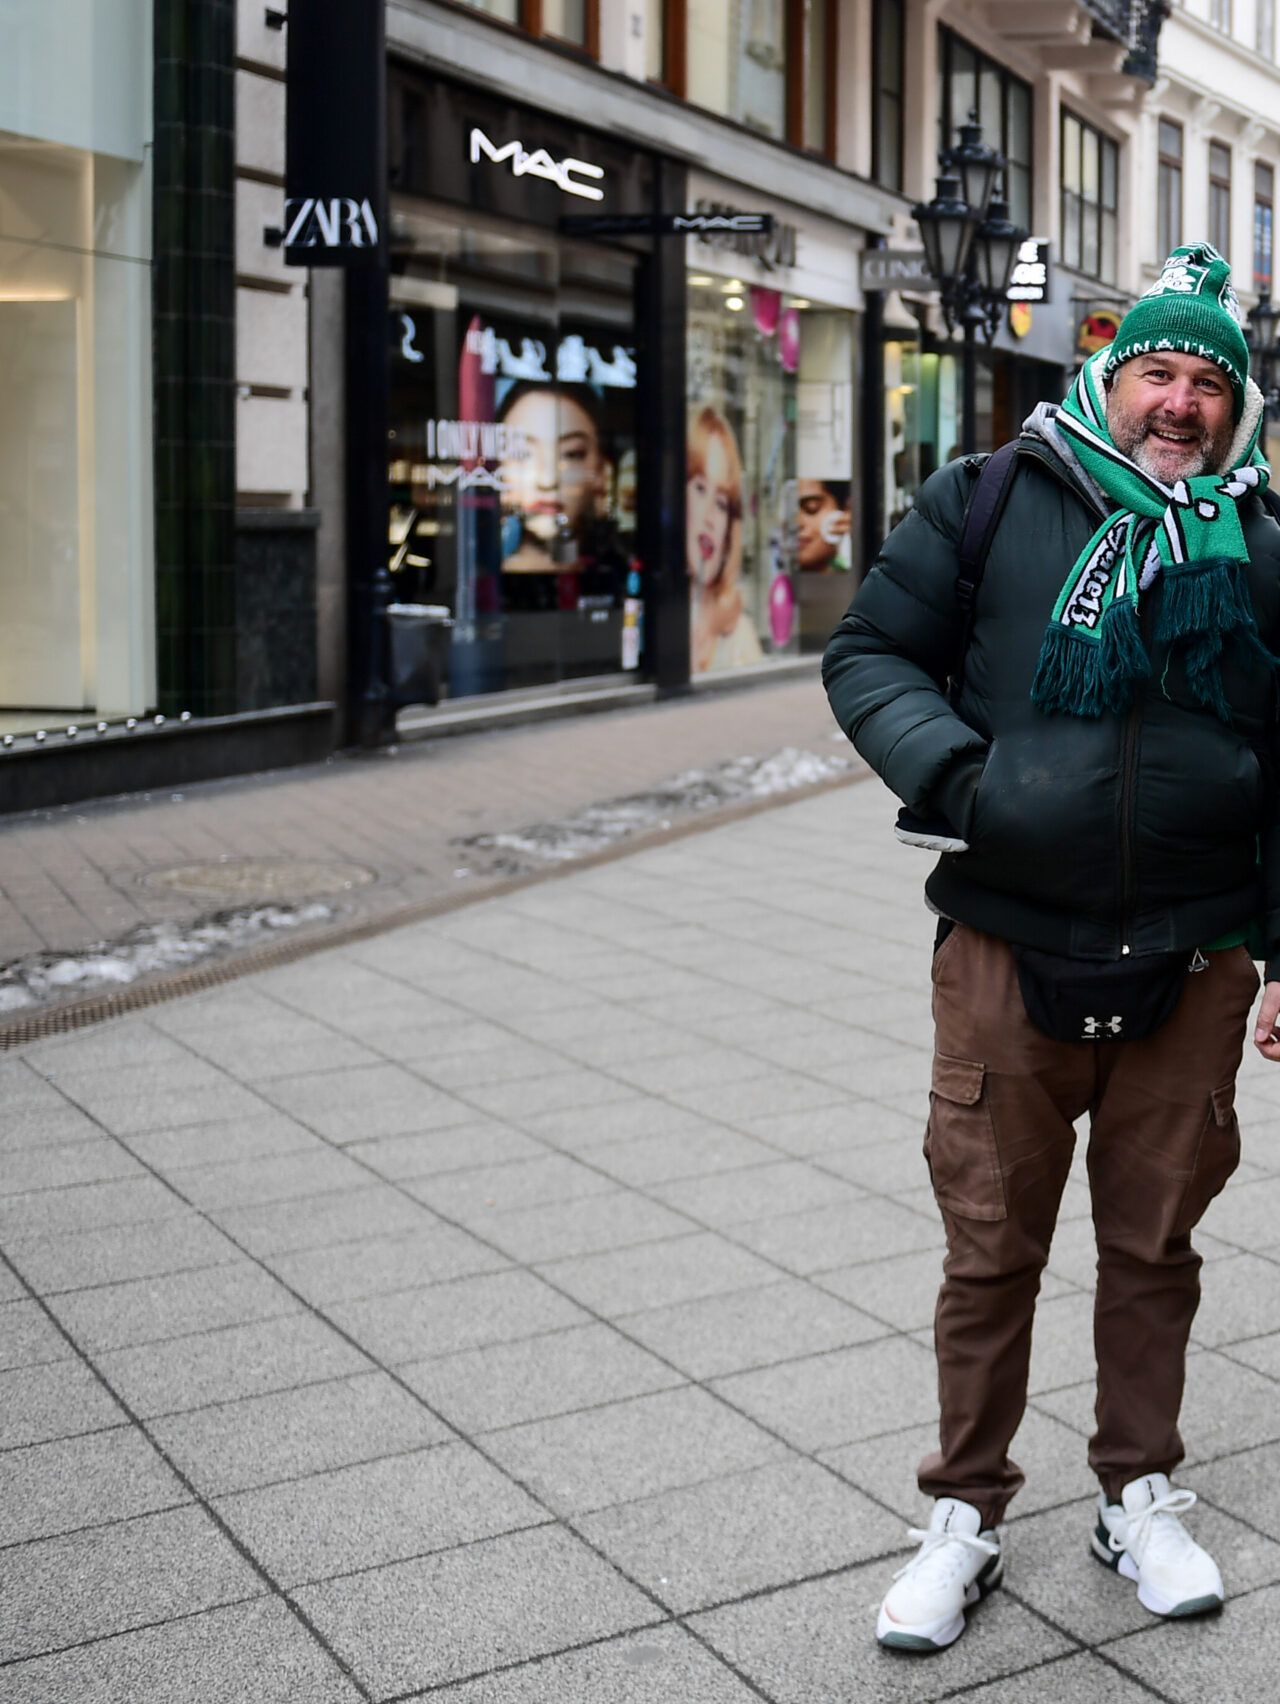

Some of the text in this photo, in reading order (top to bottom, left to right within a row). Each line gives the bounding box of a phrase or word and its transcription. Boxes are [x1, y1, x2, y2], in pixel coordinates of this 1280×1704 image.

[470, 128, 604, 200] MAC
[284, 197, 378, 247] ZARA
[673, 216, 763, 231] MAC
